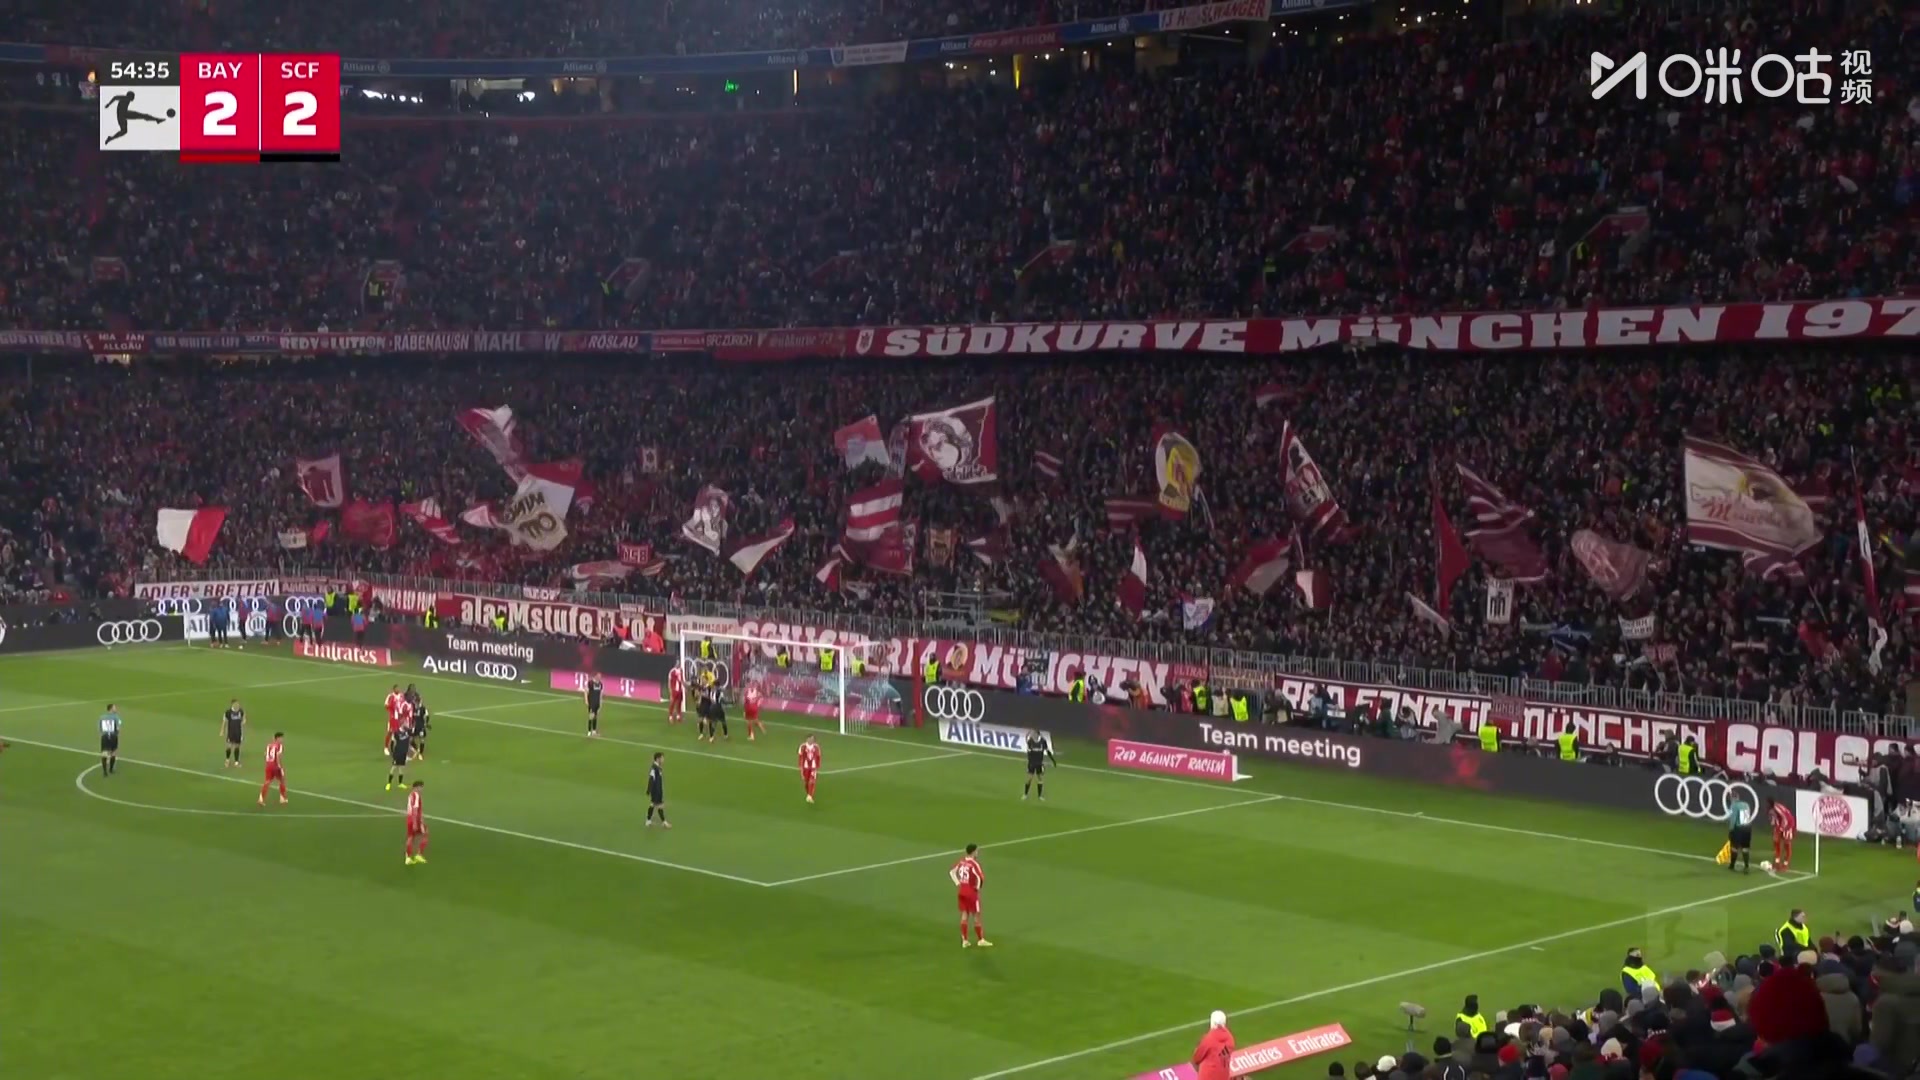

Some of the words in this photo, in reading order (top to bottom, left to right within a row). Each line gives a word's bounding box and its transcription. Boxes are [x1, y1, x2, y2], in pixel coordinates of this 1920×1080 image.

[1091, 23, 1116, 33] Allianz
[940, 41, 966, 51] Allianz
[343, 61, 375, 72] Allianz
[563, 61, 593, 72] Allianz
[767, 55, 796, 65] Allianz
[884, 321, 1247, 356] SÜDKURVE
[447, 634, 479, 651] Team
[481, 640, 534, 663] meeting
[423, 655, 467, 675] Audi
[620, 678, 635, 697] T
[947, 720, 1021, 749] Allianz
[1200, 723, 1258, 749] Team
[1265, 735, 1361, 767] meeting
[1114, 746, 1136, 761] RED
[1138, 752, 1186, 768] AGAINST
[1187, 754, 1225, 775] RACISM
[1287, 1030, 1345, 1055] Emirates
